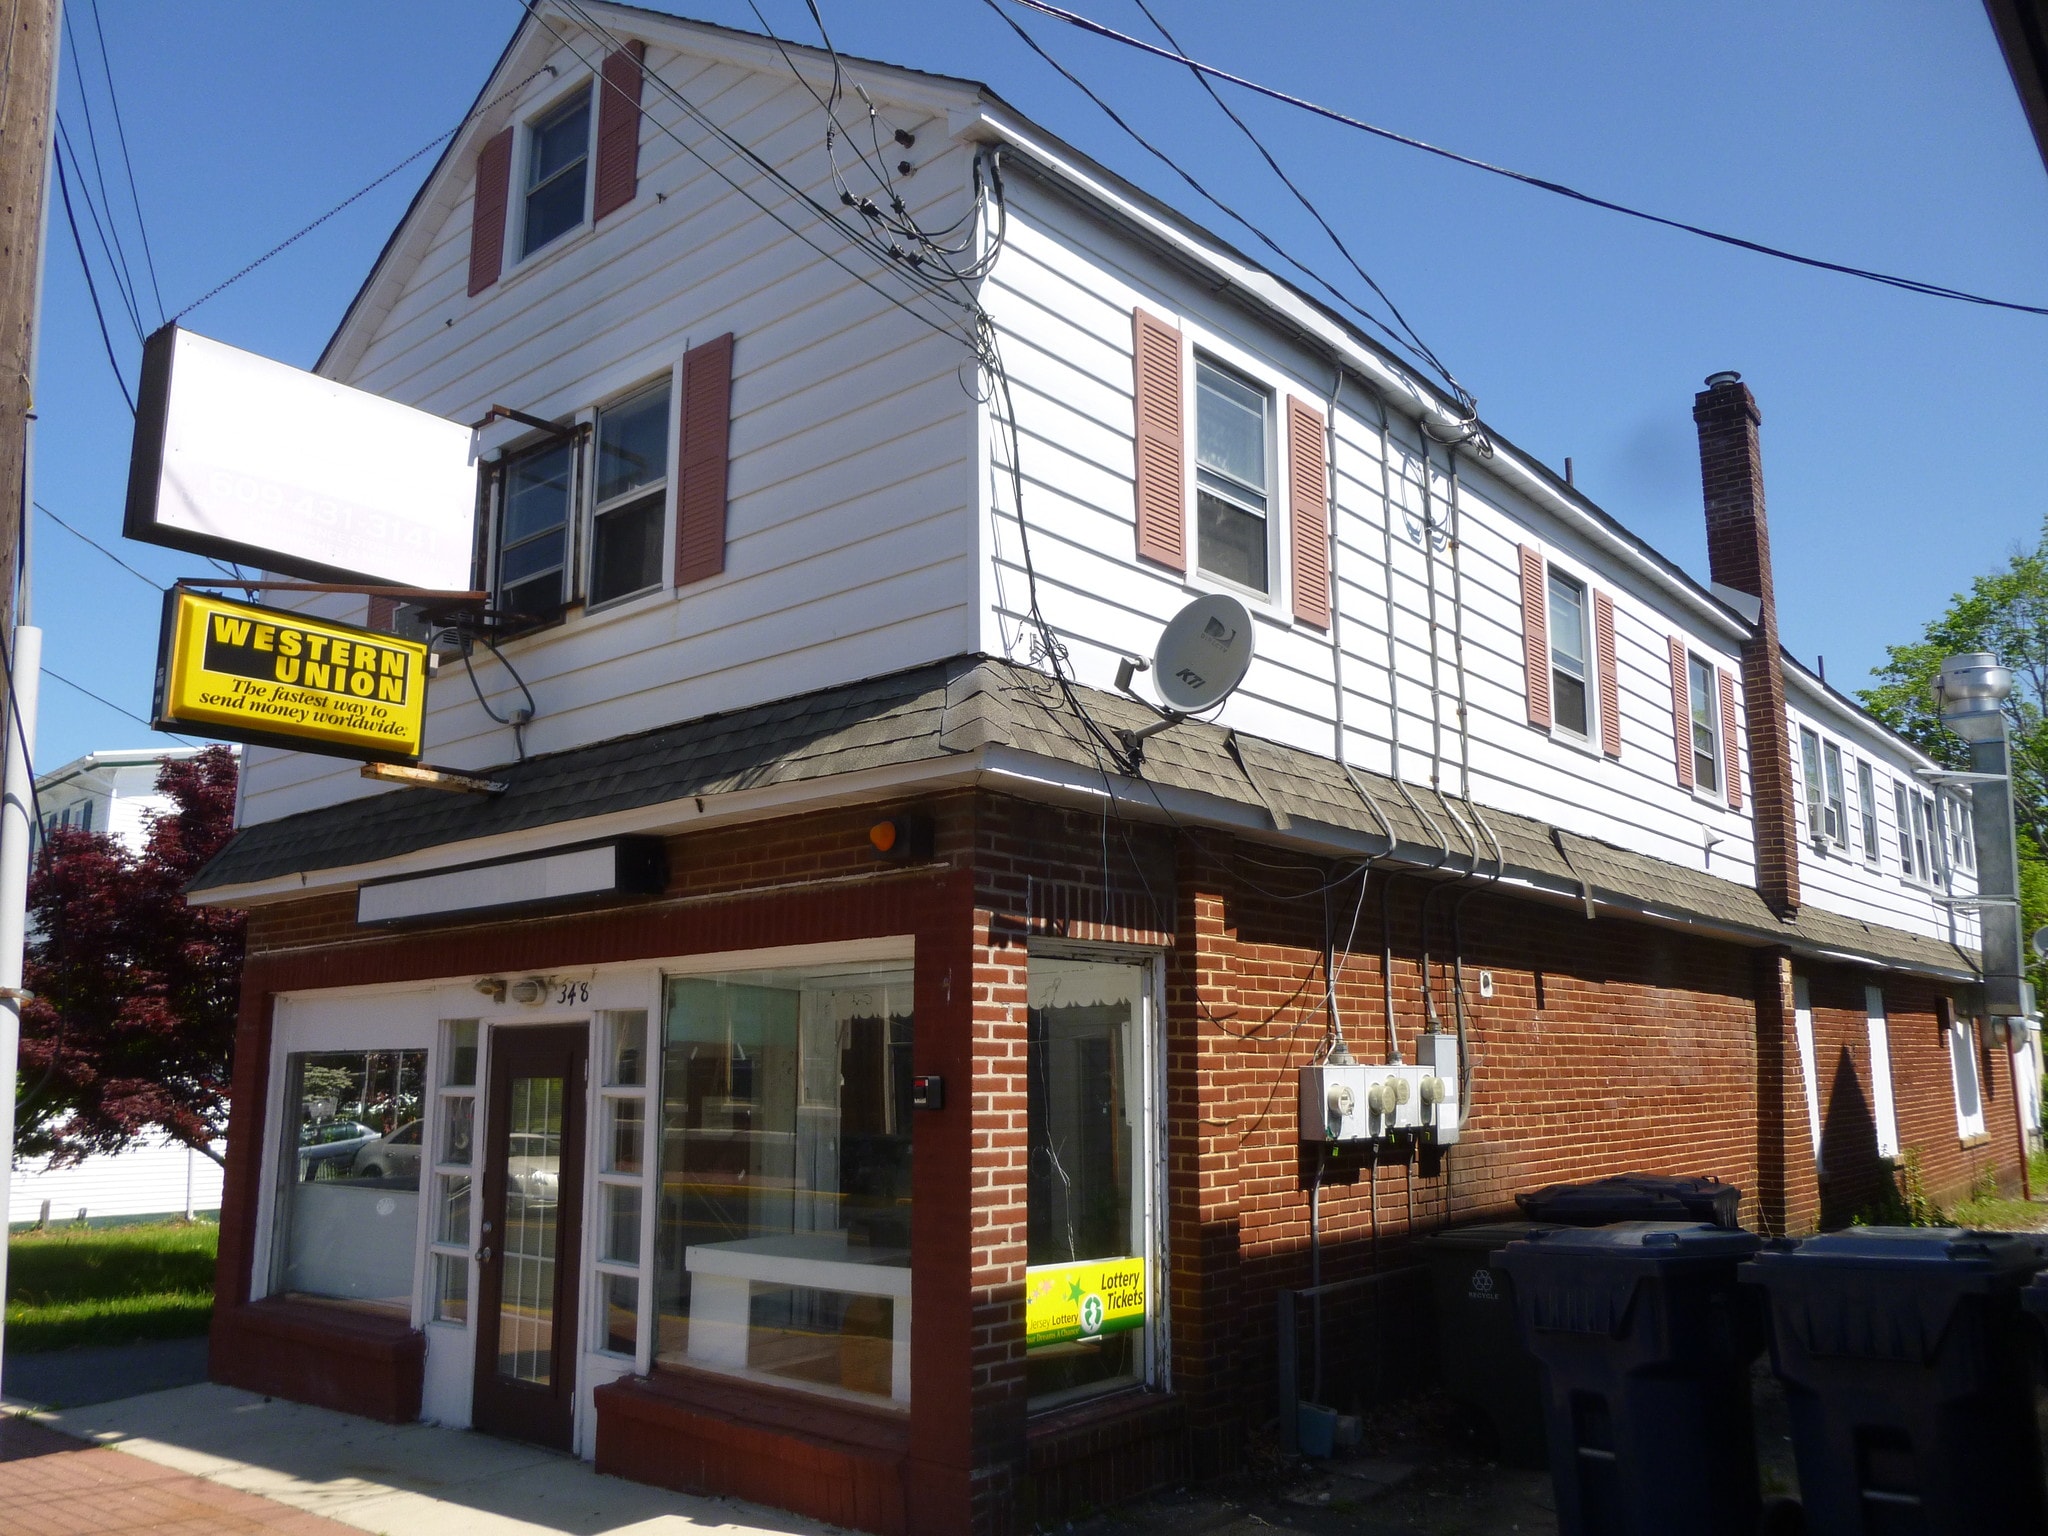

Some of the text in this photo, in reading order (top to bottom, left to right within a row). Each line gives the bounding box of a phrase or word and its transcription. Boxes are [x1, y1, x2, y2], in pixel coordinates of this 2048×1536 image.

[213, 615, 406, 678] WESTERN
[275, 655, 404, 703] UNION
[1175, 667, 1207, 690] KTI
[199, 691, 245, 709] send
[249, 699, 309, 723] money
[231, 678, 388, 718] The fastest way to
[557, 981, 589, 1006] 348
[1101, 1271, 1140, 1291] Lottery
[1107, 1289, 1143, 1310] Tickets
[1030, 1313, 1079, 1330] Jersey Lottery
[1036, 1333, 1056, 1342] Dreams
